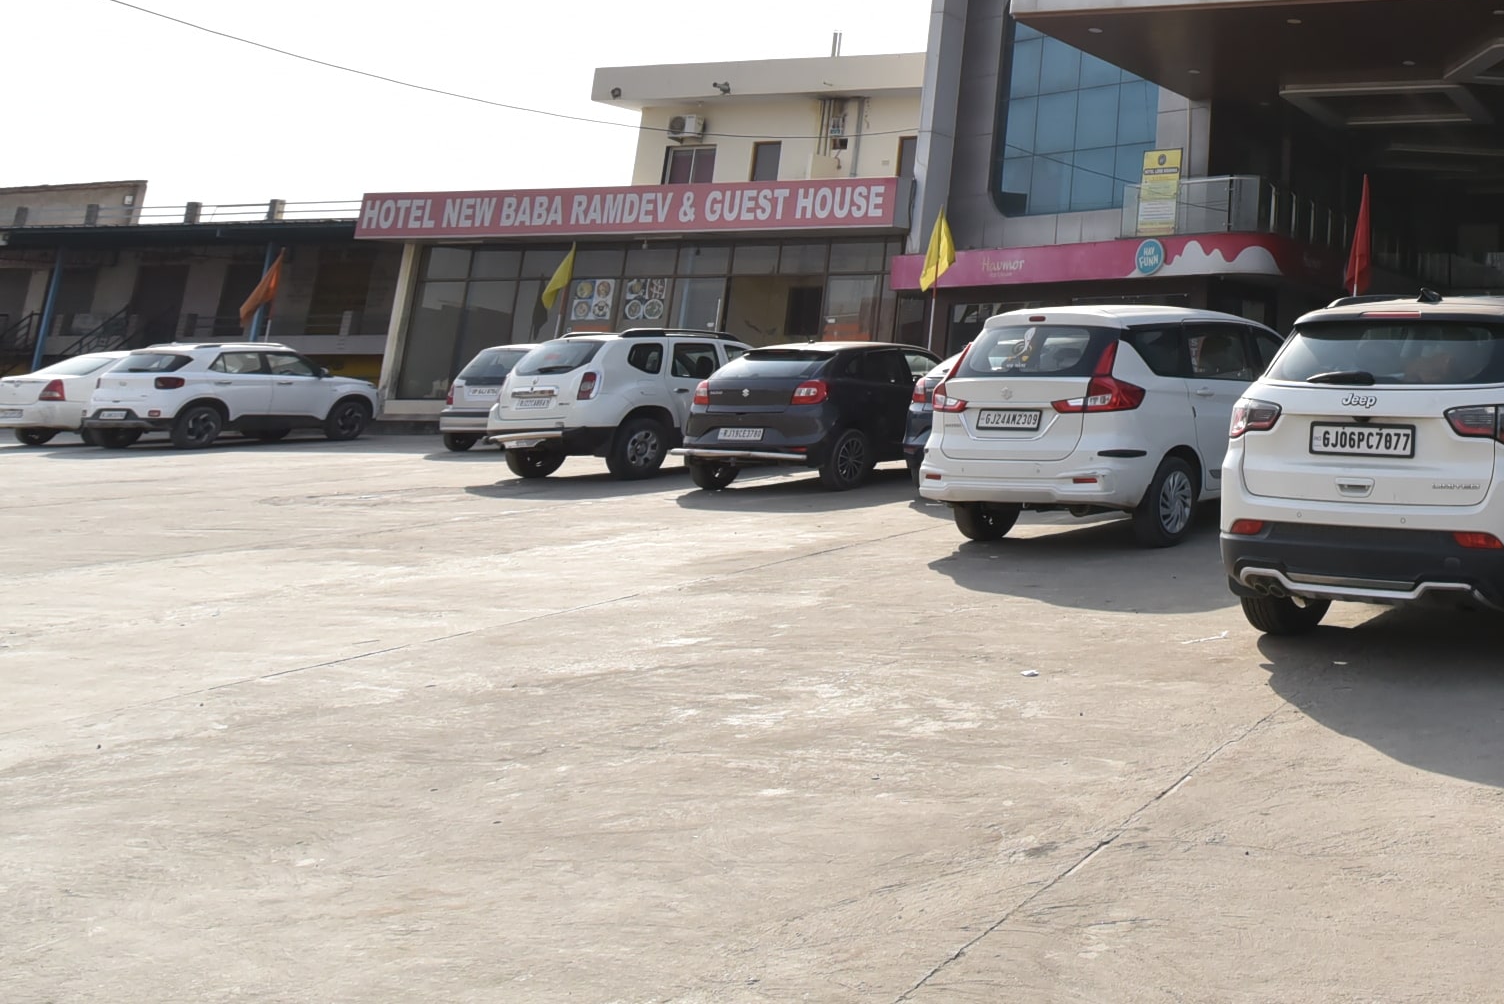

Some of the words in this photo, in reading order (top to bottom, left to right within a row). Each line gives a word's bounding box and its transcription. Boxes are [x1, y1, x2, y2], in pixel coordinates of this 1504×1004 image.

[362, 200, 436, 229] HOTEL
[441, 198, 496, 228] NEW
[502, 196, 562, 227] BABA
[570, 192, 672, 224] RAMDEV
[678, 192, 696, 222] &
[704, 188, 789, 221] GUEST
[795, 185, 885, 218] HOUSE
[982, 256, 1025, 272] Havmor
[1341, 392, 1377, 408] Jeep
[985, 413, 1038, 426] GJ24AM2309
